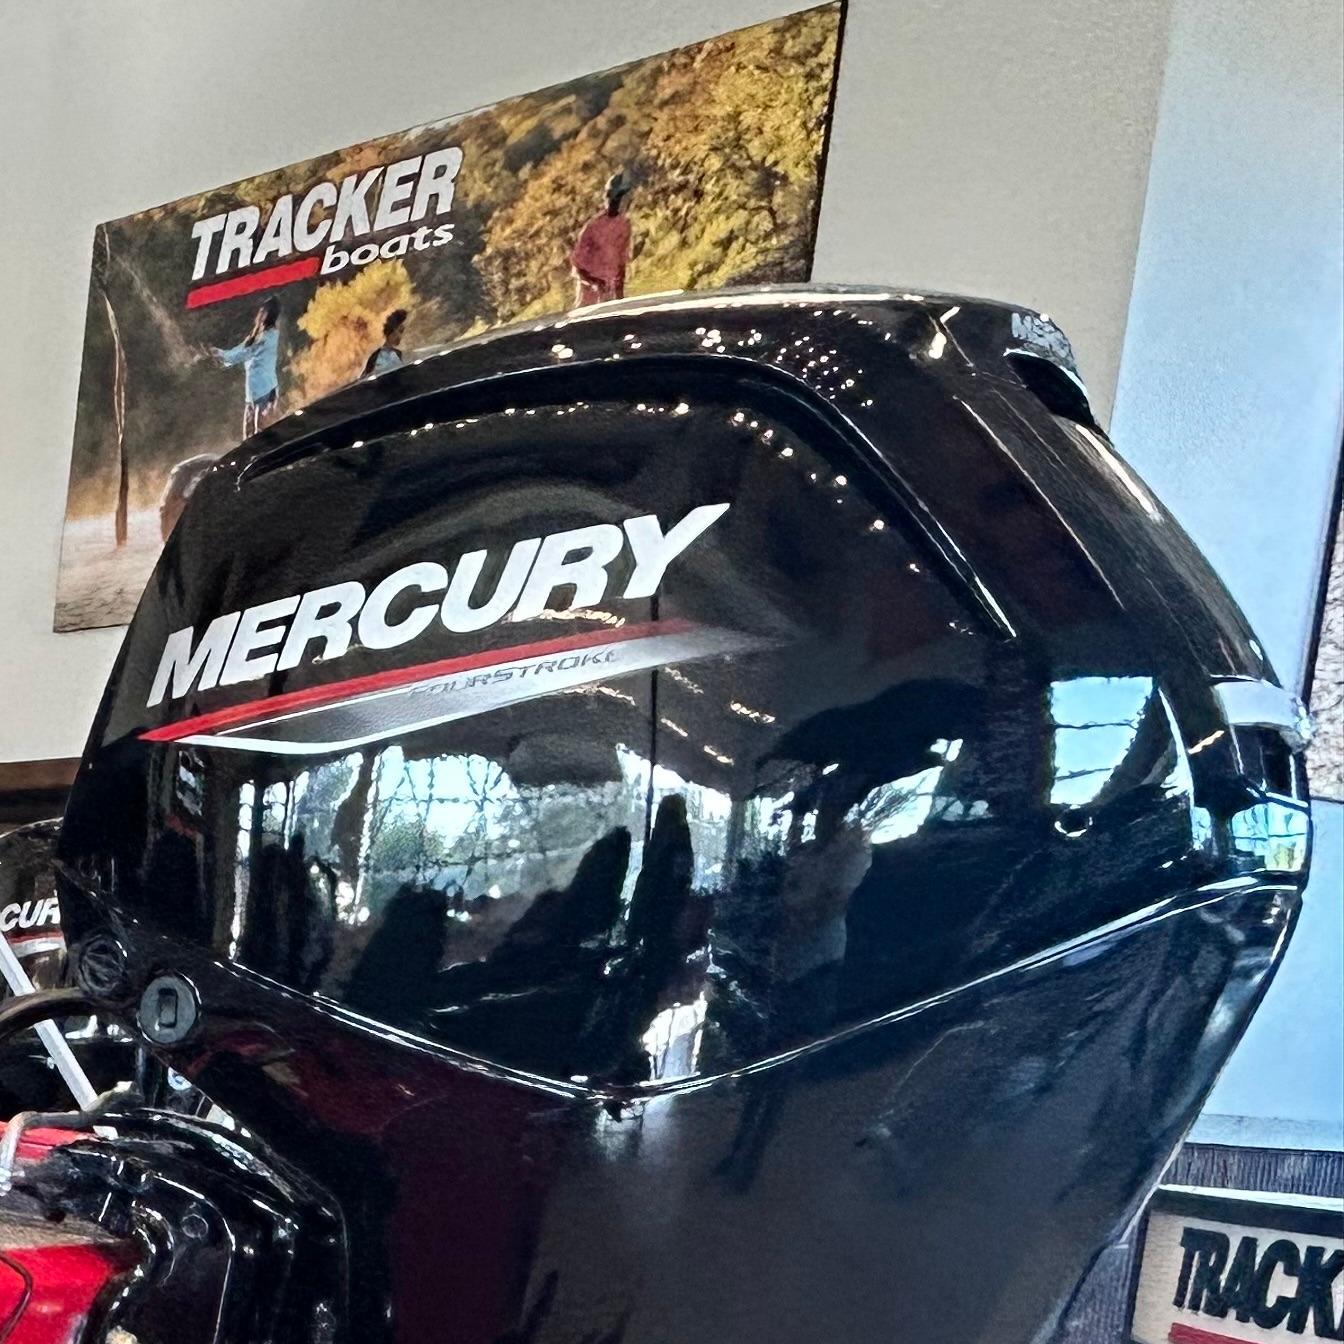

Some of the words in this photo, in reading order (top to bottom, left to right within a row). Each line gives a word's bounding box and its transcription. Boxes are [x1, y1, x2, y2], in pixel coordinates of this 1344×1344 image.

[191, 147, 463, 281] TRACKER
[320, 223, 455, 276] boats
[147, 502, 730, 707] MERCURY
[1172, 1226, 1344, 1342] TRACK
